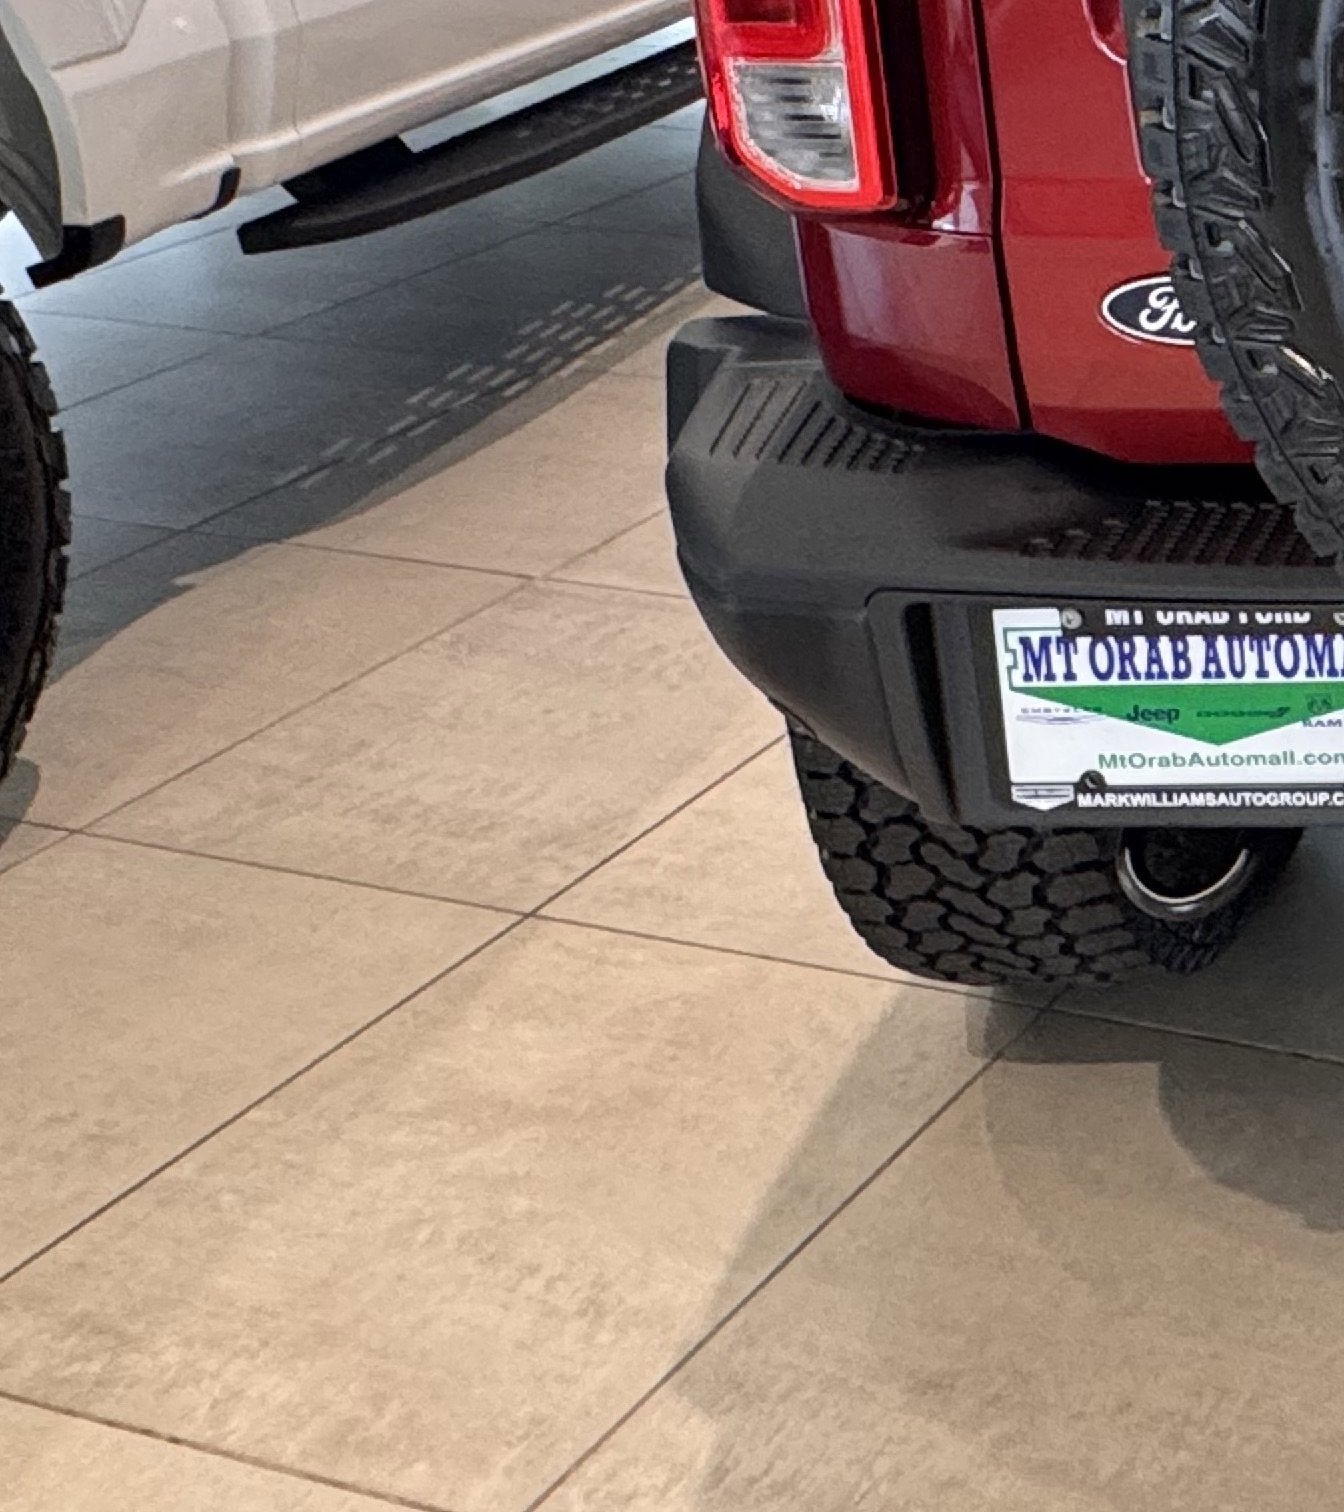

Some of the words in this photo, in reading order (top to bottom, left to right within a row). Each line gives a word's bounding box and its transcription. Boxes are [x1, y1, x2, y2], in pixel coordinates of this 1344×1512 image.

[1018, 635, 1078, 682] MT
[1087, 634, 1192, 681] ORAB
[1126, 704, 1180, 724] Jeep
